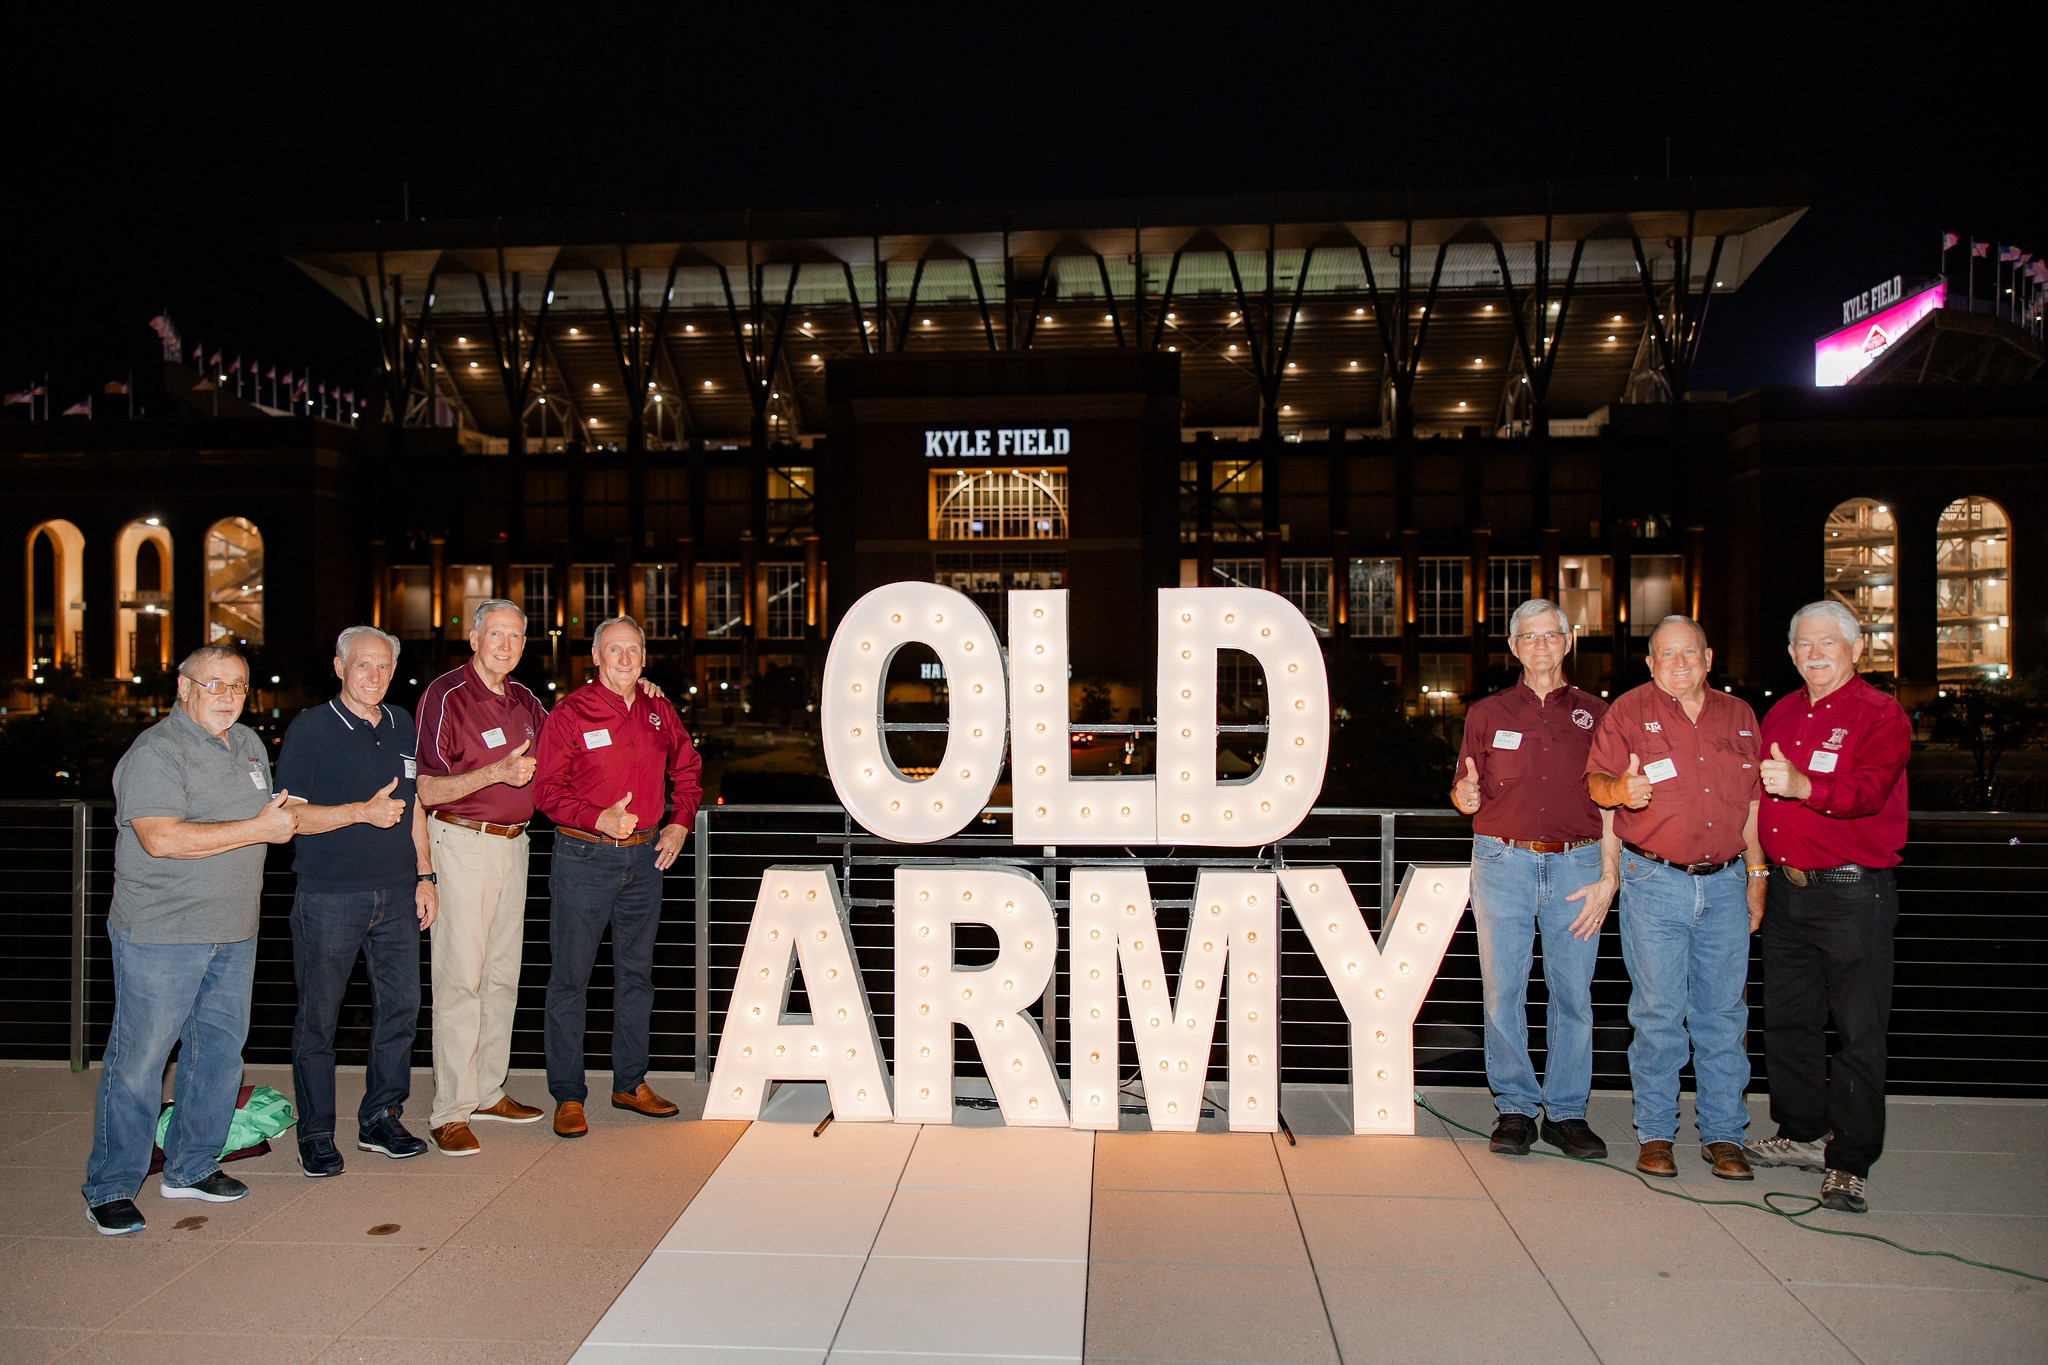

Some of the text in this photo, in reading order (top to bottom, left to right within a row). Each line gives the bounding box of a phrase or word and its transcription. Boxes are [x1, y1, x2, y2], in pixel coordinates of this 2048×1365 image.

[1842, 275, 1902, 324] KYLE FIELD
[925, 428, 1070, 457] KYLE FIELD
[821, 581, 1329, 847] OLD
[703, 863, 1471, 1135] ARMY
